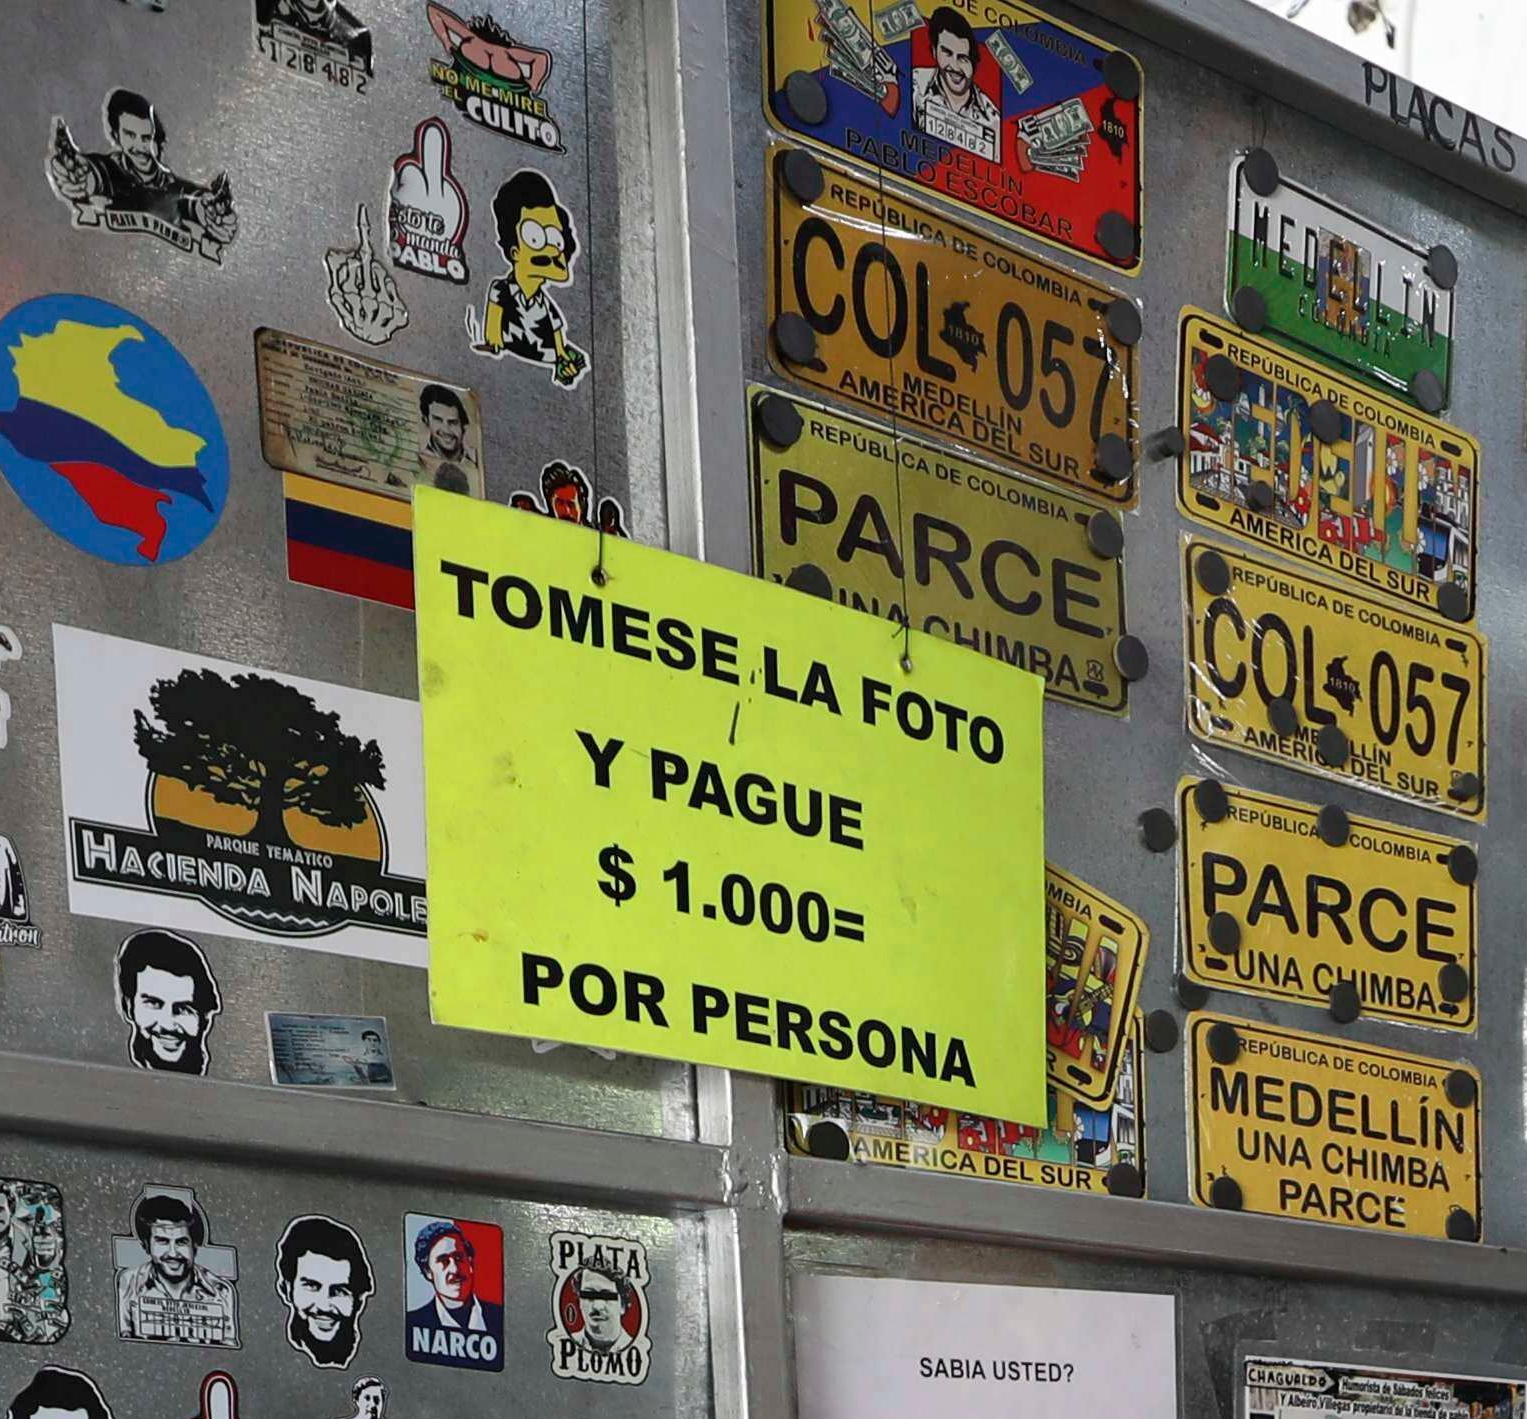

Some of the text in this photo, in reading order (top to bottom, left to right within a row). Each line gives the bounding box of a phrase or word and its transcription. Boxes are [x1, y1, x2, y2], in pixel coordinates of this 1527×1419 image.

[984, 6, 1088, 68] COLOMBIA
[432, 65, 545, 115] NO ME MIRE
[445, 85, 559, 146] EL CULITO
[1362, 61, 1517, 174] PLACAS
[845, 128, 1074, 240] PABLO ESCOBAR
[793, 219, 1121, 447] COL 057
[839, 372, 1080, 479] AMERICA DEL SUR
[903, 372, 1023, 435] MEDELLÍN
[780, 469, 1105, 640] PARCE
[440, 560, 1005, 765] TOMESE LA FOTO
[1204, 596, 1471, 765] COL 057
[575, 729, 864, 851] Y PAGUE
[84, 828, 426, 923] HACIENDA NAPOLE
[206, 834, 333, 869] PARQUE TEMATICO
[598, 844, 865, 943] $ 1.000=
[1201, 852, 1458, 963] PARCE
[521, 953, 977, 1089] POR PERSONA
[1210, 1067, 1465, 1155] MEDELLÍN
[1237, 1127, 1450, 1192] UNA CHIMBA
[1279, 1179, 1407, 1228] PARCE
[559, 1241, 642, 1279] PLATA
[411, 1326, 497, 1361] NARCO
[559, 1342, 642, 1377] PLOMO
[920, 1357, 1075, 1382] SABIA USTED?
